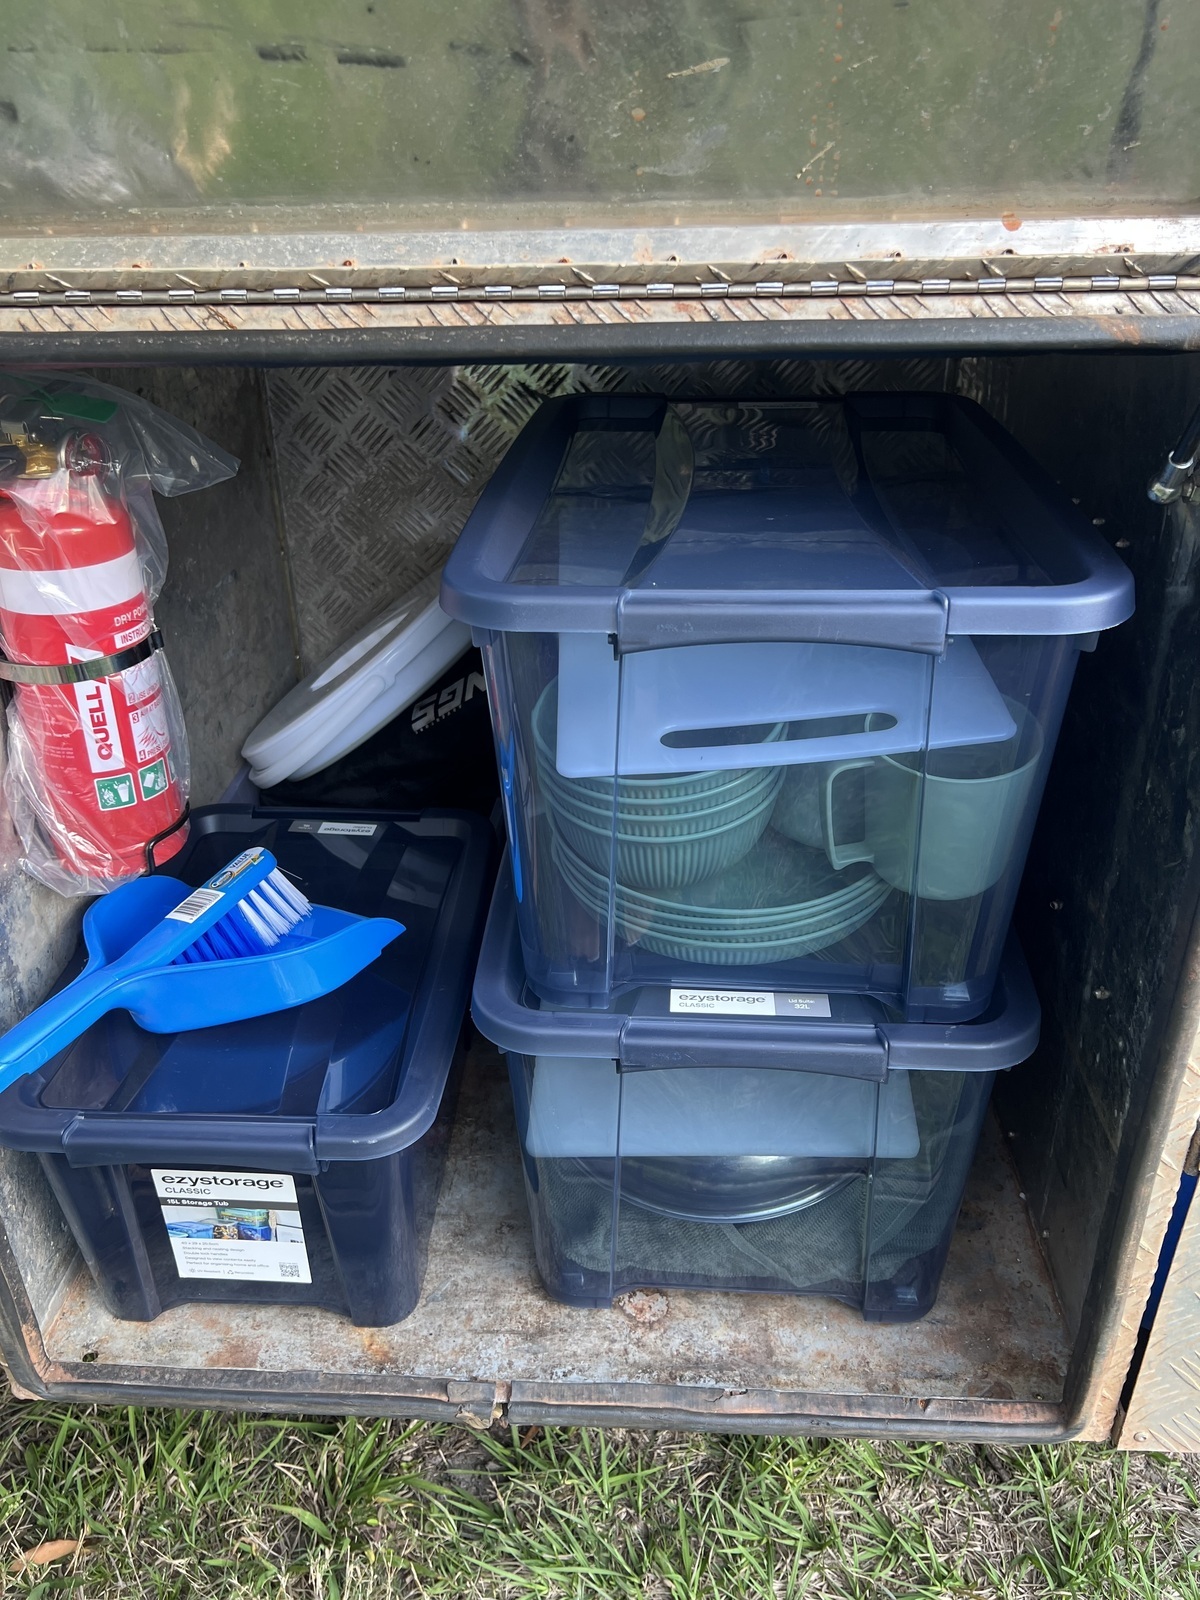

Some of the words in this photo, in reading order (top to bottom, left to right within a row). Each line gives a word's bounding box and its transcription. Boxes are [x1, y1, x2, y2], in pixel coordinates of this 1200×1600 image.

[114, 611, 132, 627] DRY
[86, 685, 113, 761] QUELL
[679, 993, 767, 1005] ezystorage
[794, 1003, 811, 1011] 32L
[161, 1175, 283, 1190] ezystorage
[164, 1187, 211, 1195] CLASSIC
